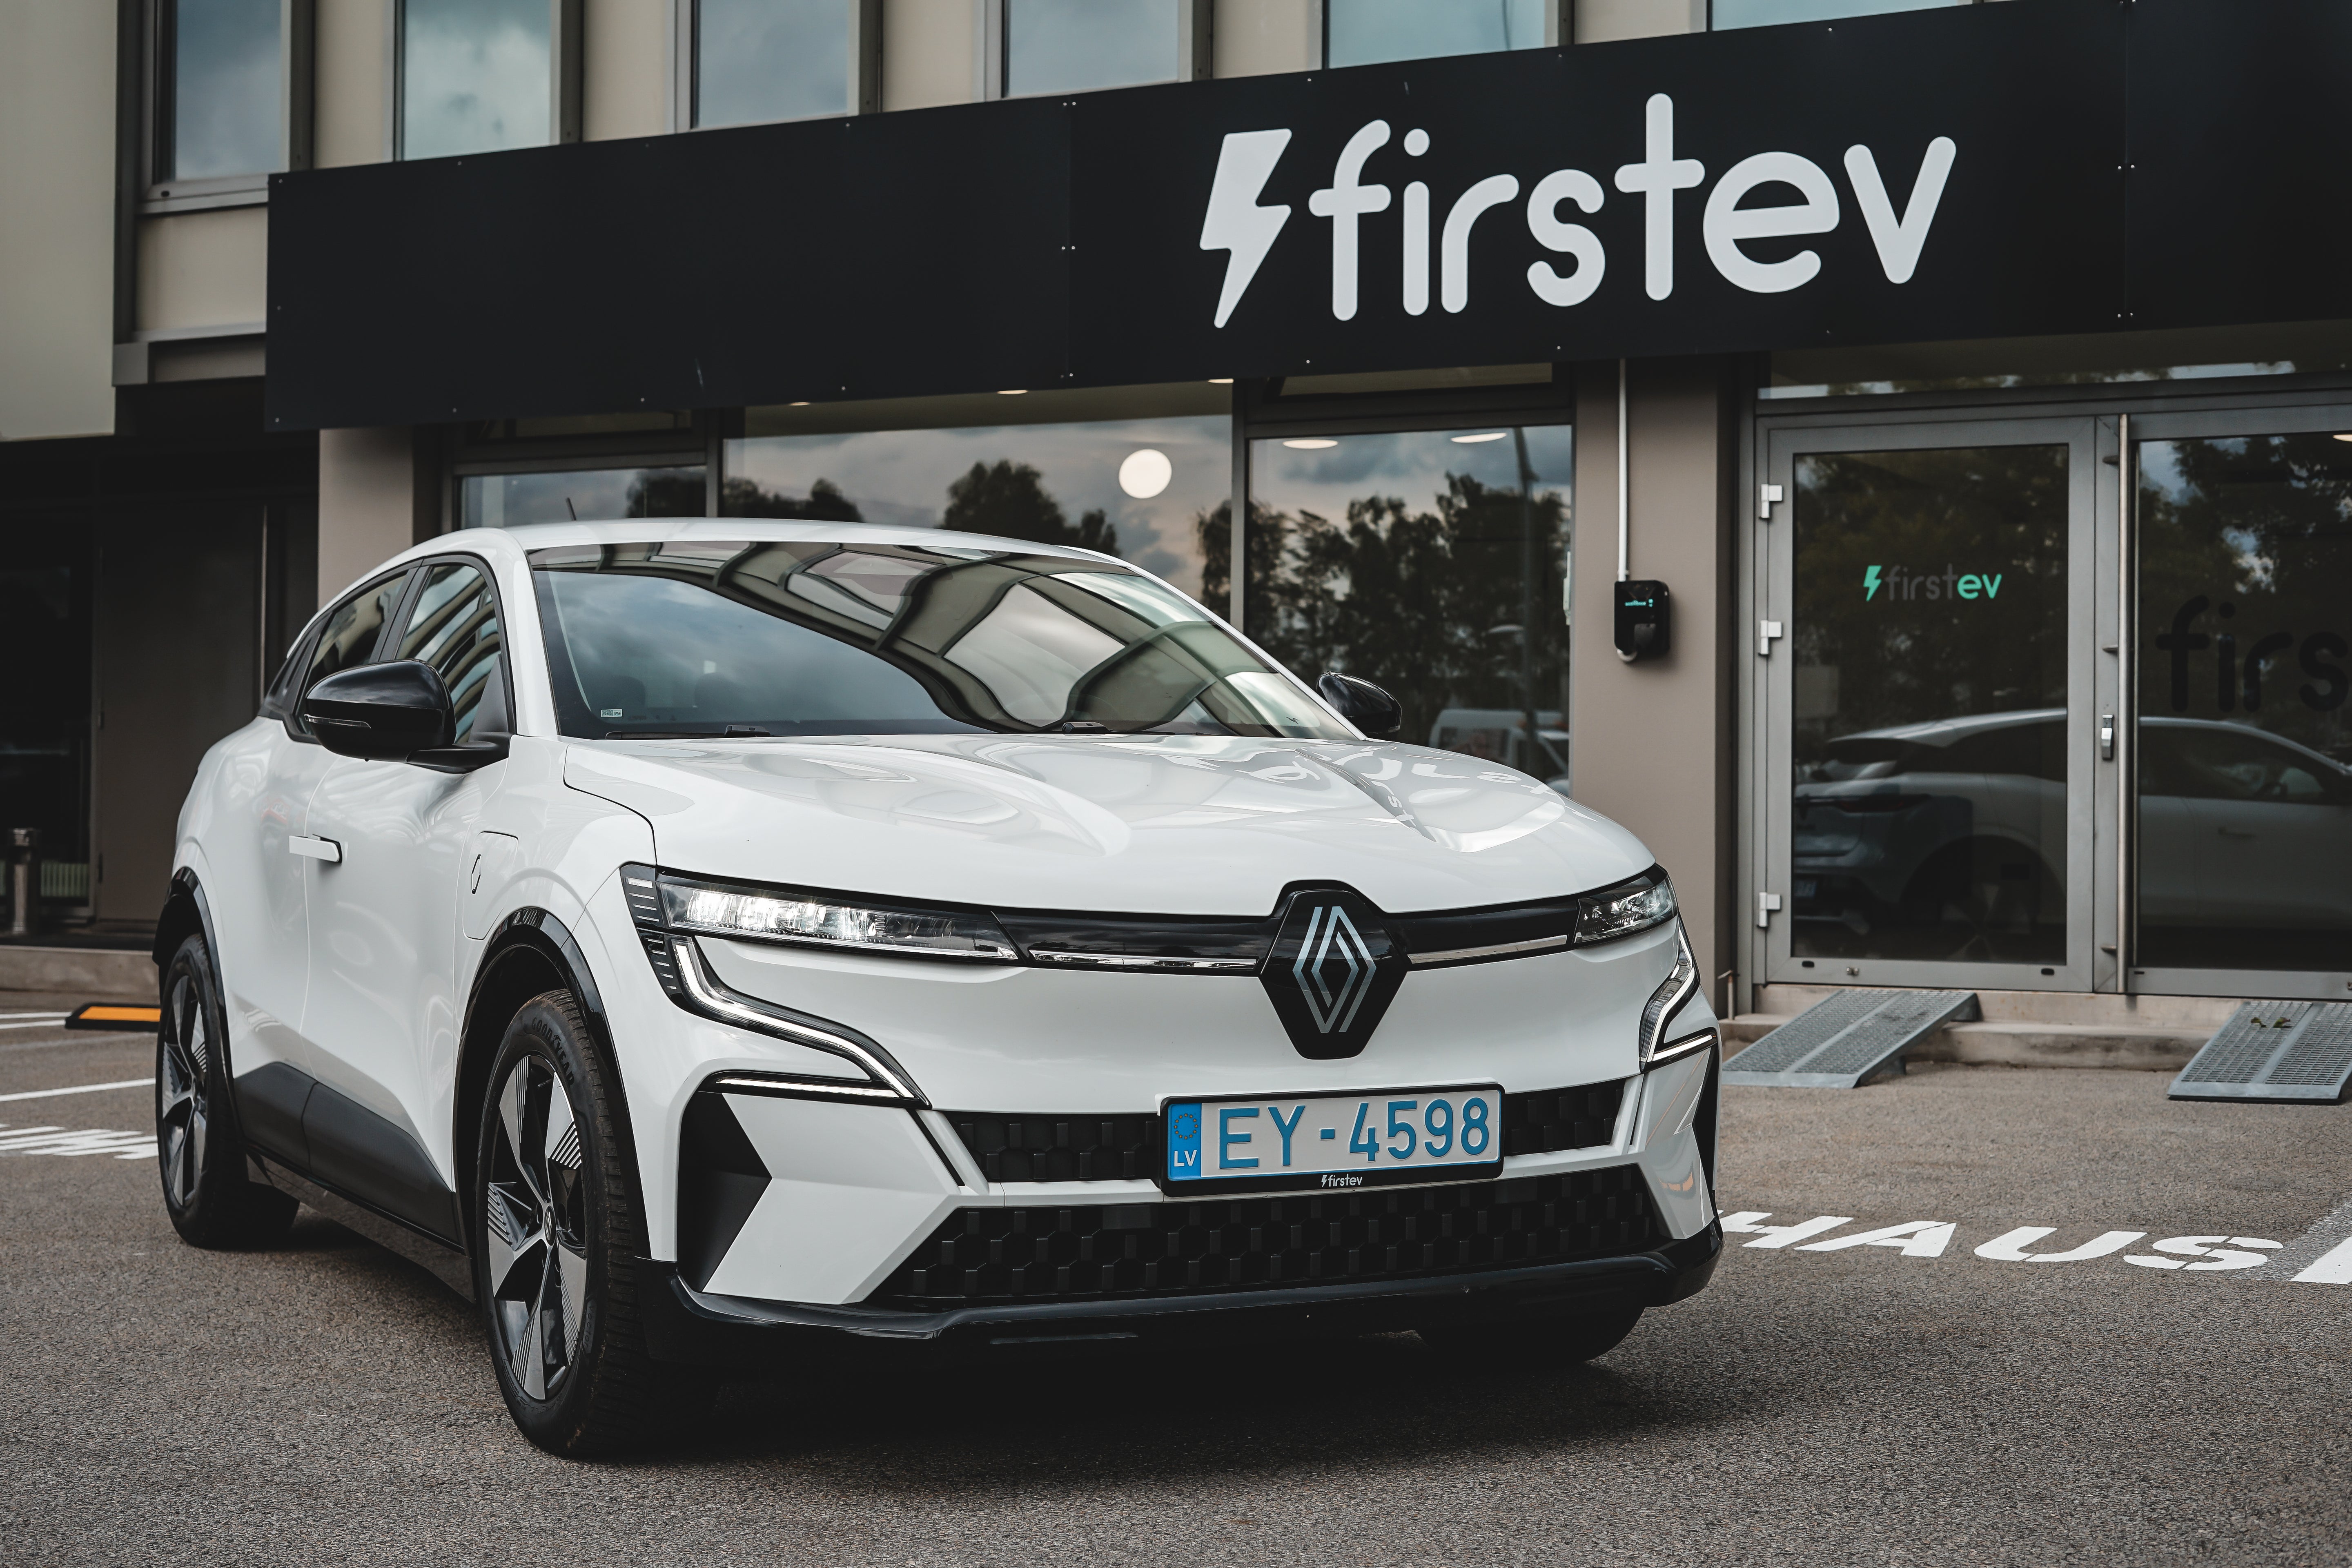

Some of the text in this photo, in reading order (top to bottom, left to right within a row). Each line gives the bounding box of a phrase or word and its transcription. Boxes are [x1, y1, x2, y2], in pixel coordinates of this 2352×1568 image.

[1308, 93, 1956, 321] firstev
[1885, 564, 2002, 601] firstev
[2156, 595, 2349, 712] firs
[531, 1016, 575, 1087] GOODYEAR
[1173, 1149, 1198, 1167] LV
[1218, 1097, 1490, 1169] EY-4598
[1328, 1174, 1363, 1187] firstev
[1717, 1209, 2284, 1271] HAUS
[584, 1306, 594, 1348] Vector
